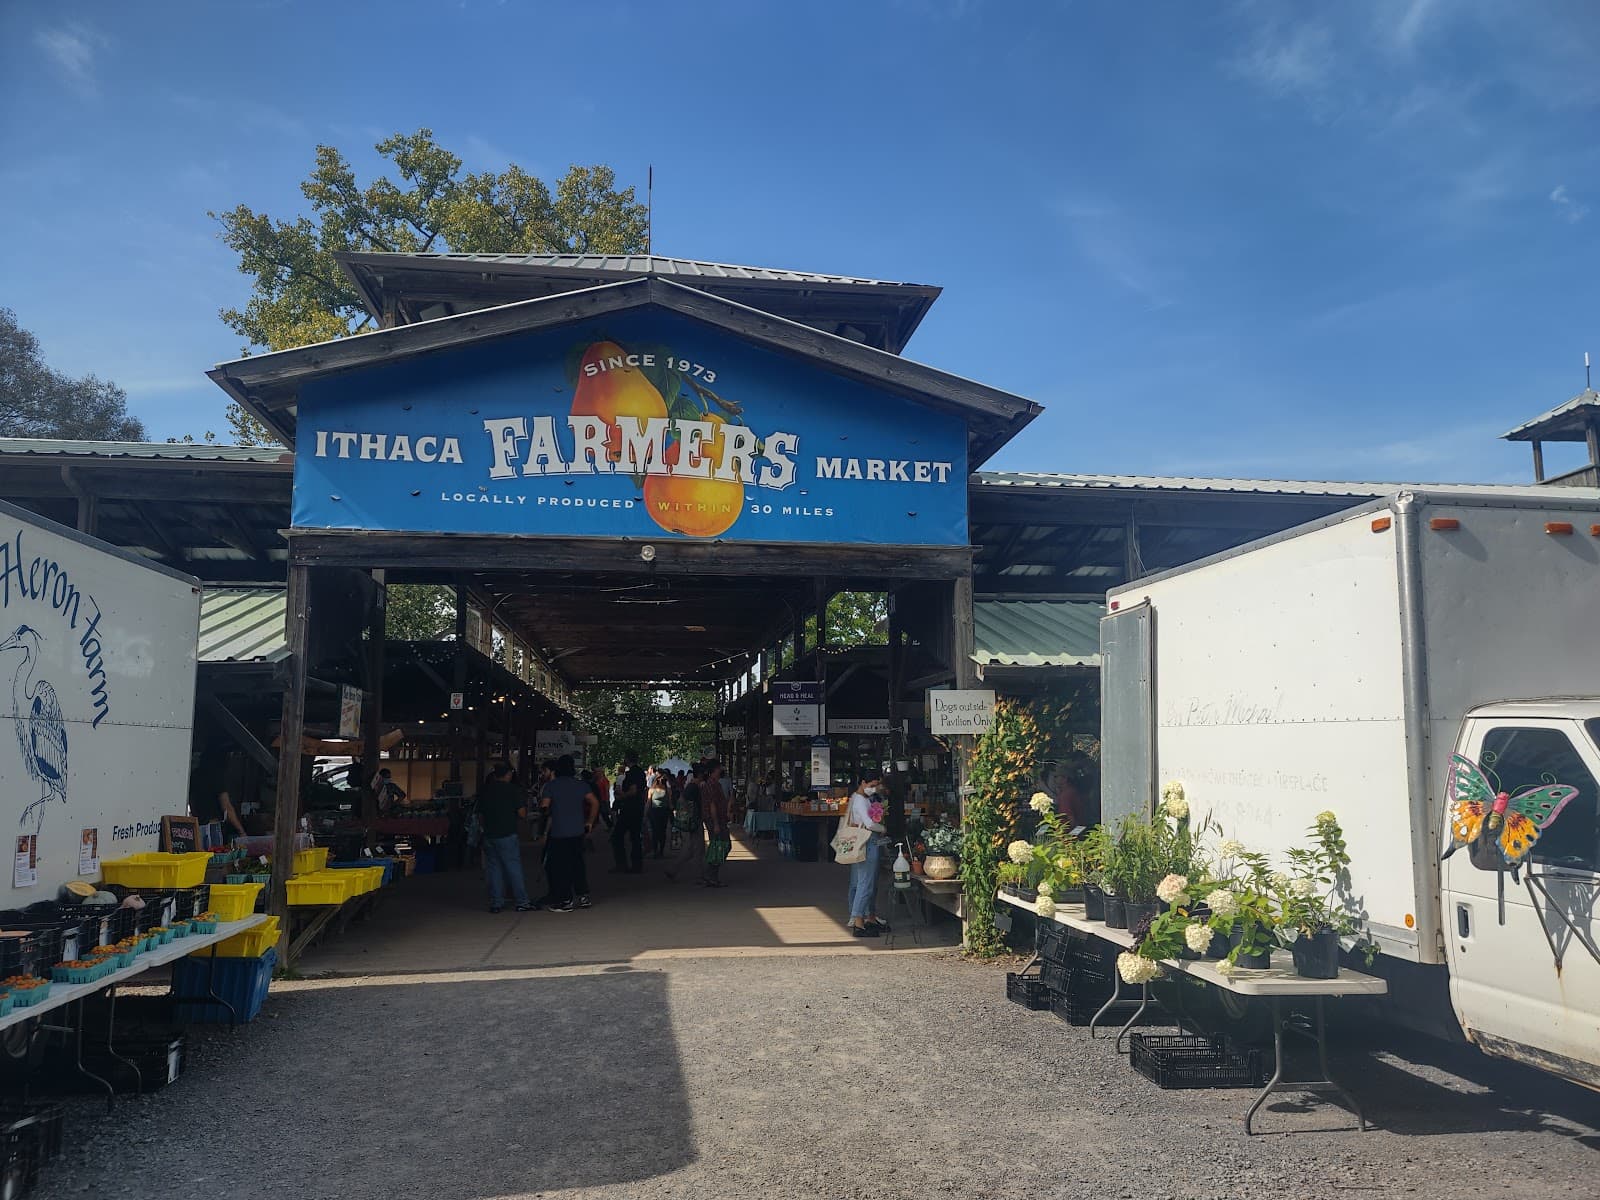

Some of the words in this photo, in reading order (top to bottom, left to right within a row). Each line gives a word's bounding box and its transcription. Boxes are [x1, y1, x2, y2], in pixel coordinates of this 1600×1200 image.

[584, 354, 656, 377] SINCE
[666, 356, 717, 383] 1973
[315, 431, 464, 464] ITHACA
[483, 415, 800, 491] FARMERS
[815, 456, 953, 483] MARKET
[441, 491, 527, 505] LOCALLY
[537, 496, 634, 508] PRODUCED
[657, 501, 733, 513] WITHIN
[751, 504, 772, 514] 30
[782, 506, 835, 516] MILES
[0, 529, 81, 630] Heron
[79, 594, 109, 730] Farm
[935, 698, 957, 714] Dogs
[959, 699, 988, 712] outside
[941, 714, 972, 727] Pavilion
[973, 713, 993, 727] Only
[112, 824, 134, 841] Fresh
[135, 820, 162, 838] Produc
